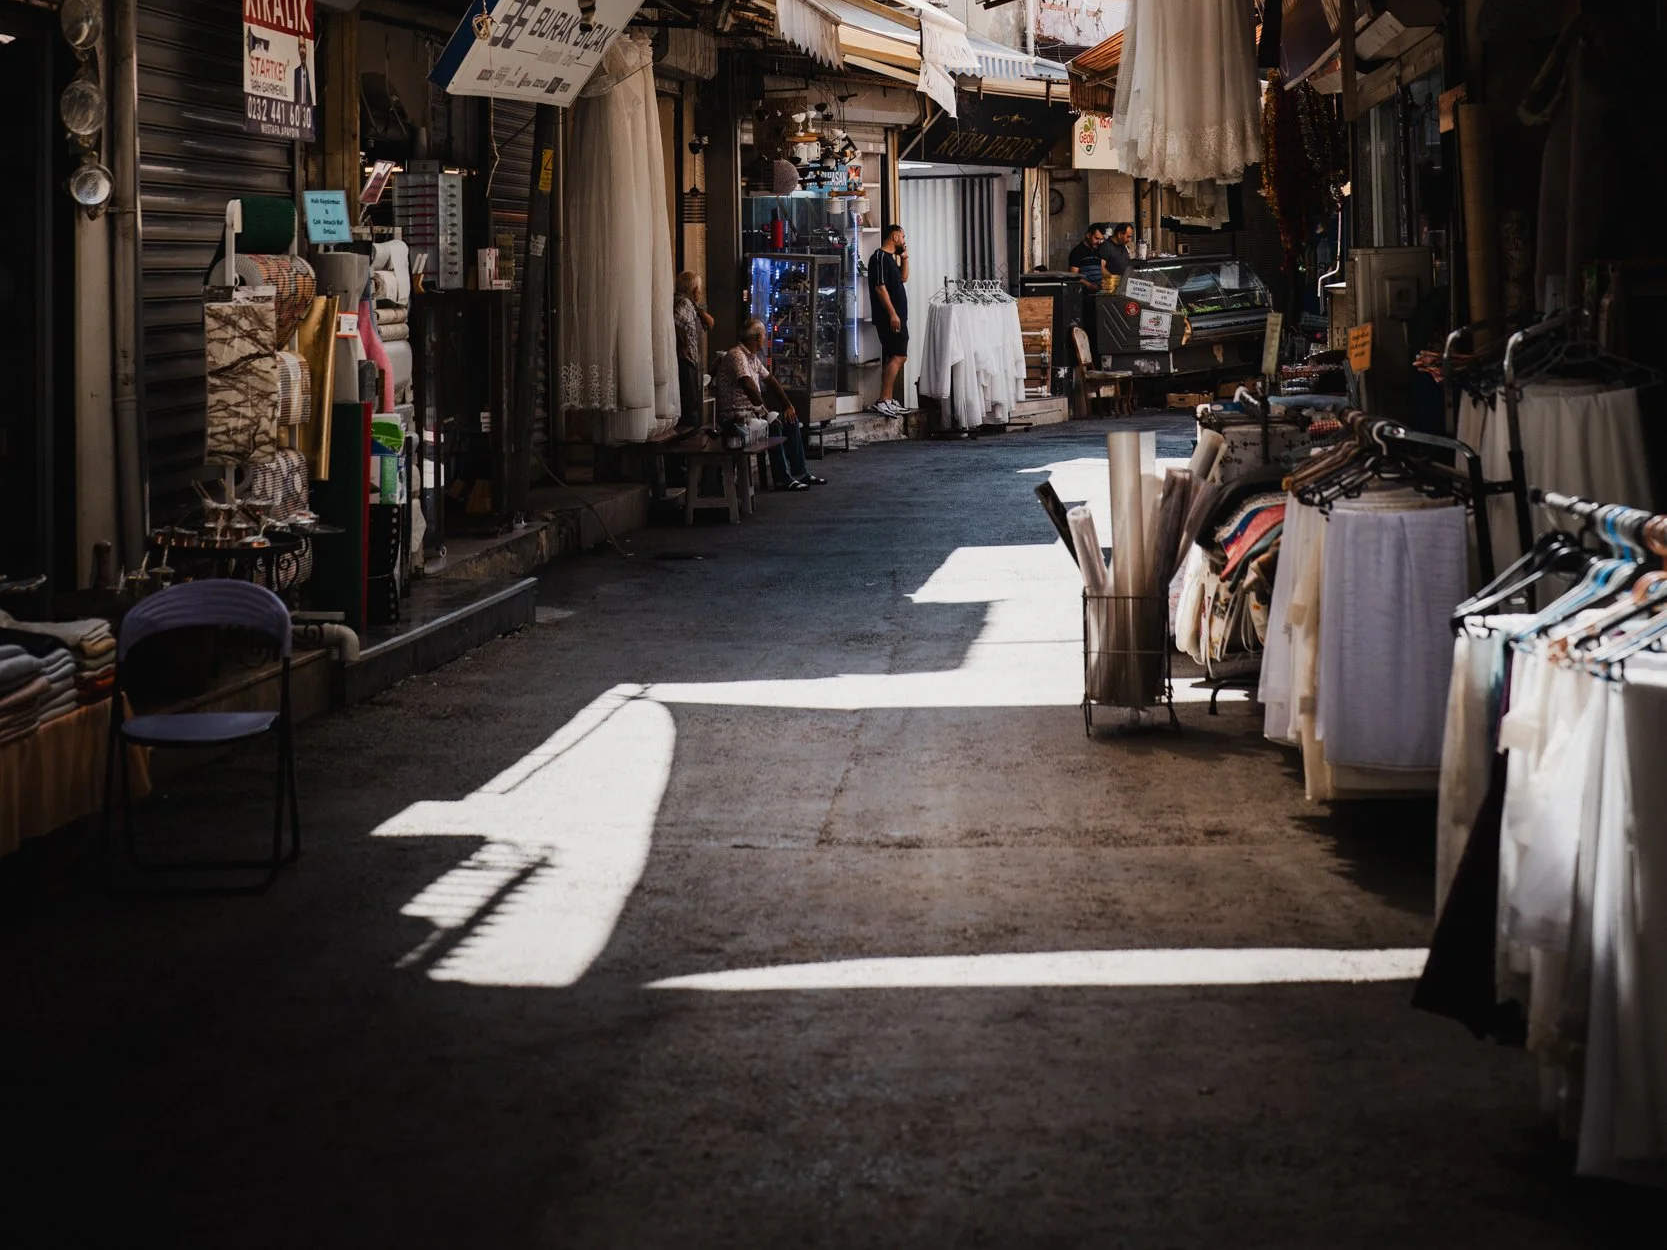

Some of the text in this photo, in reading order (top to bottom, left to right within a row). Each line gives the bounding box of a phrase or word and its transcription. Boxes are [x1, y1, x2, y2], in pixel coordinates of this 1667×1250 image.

[528, 7, 582, 46] BURAK
[250, 55, 287, 82] STARTKEY
[247, 96, 312, 129] 0232 441 60 30
